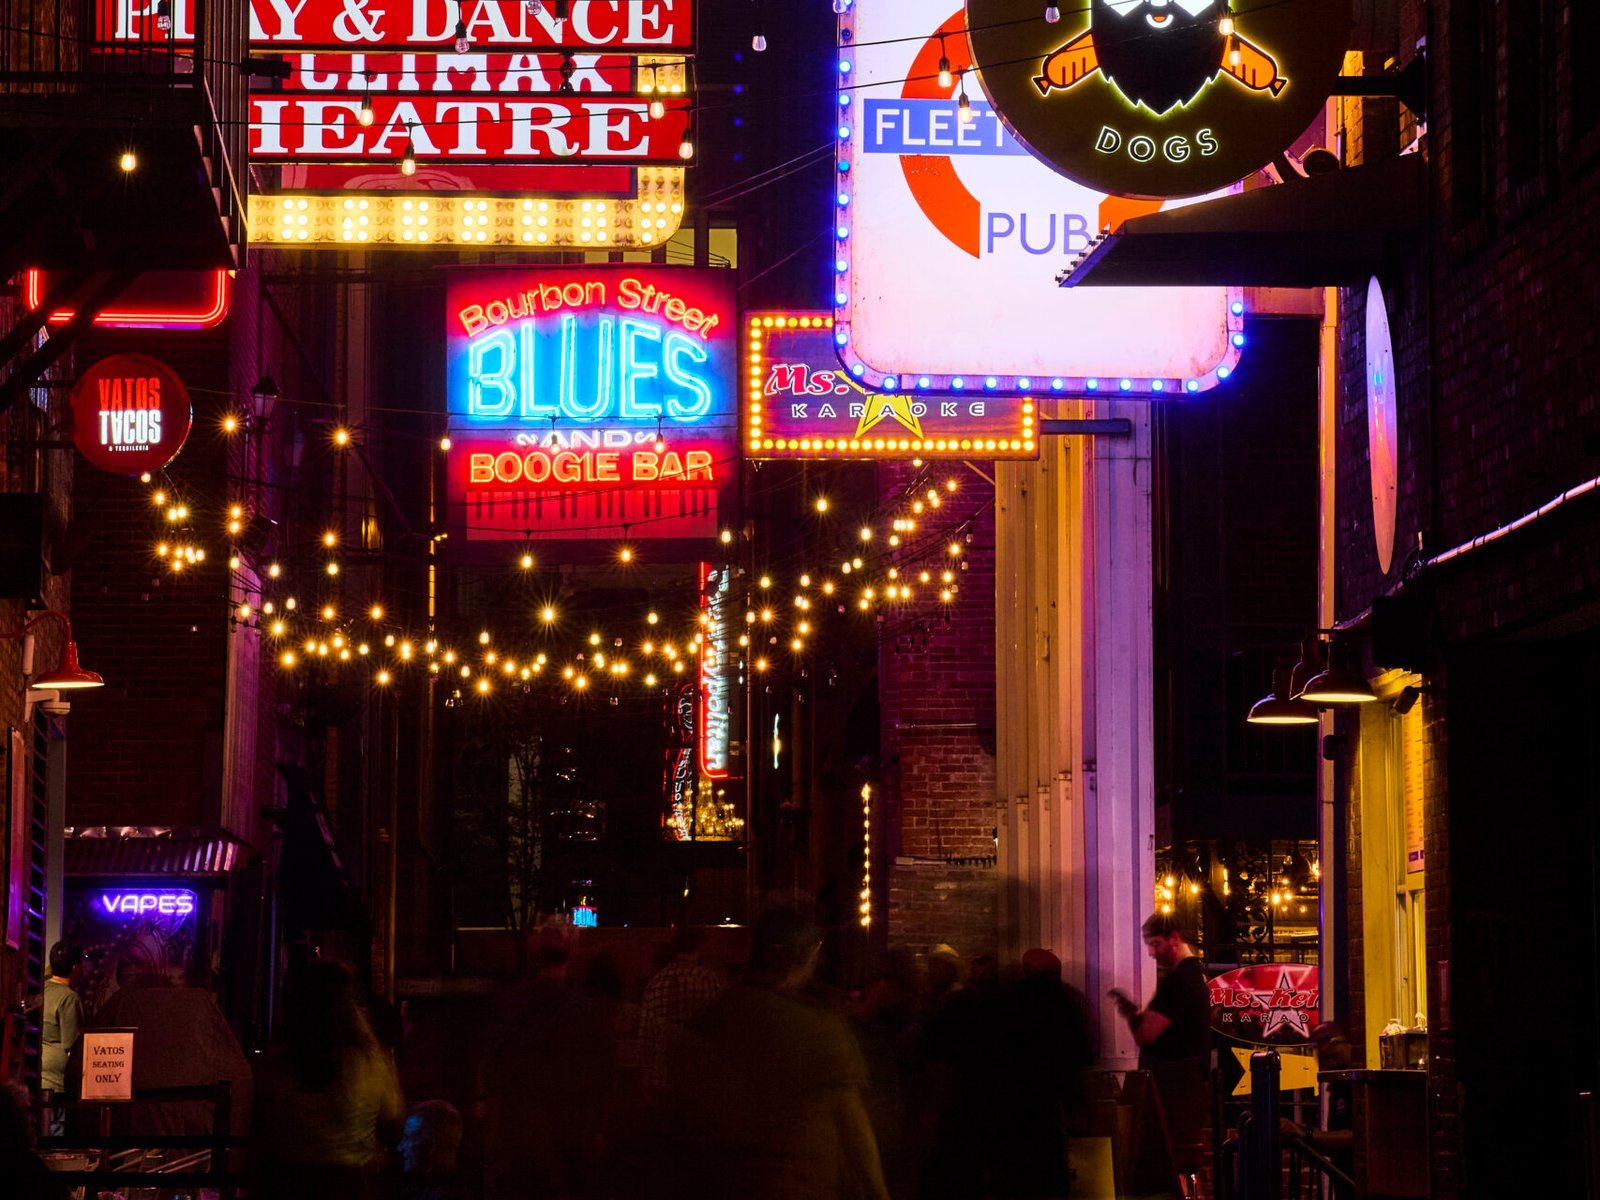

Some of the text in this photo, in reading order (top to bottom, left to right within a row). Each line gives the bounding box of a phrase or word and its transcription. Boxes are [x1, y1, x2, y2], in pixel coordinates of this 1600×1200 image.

[1095, 126, 1218, 162] DOGS
[987, 212, 1092, 255] PUB
[459, 278, 719, 339] Bourbon Street
[468, 314, 712, 422] BLUES
[764, 363, 849, 395] Ms.
[99, 377, 161, 410] VATOS
[792, 402, 985, 418] KARAOKE
[99, 409, 161, 444] TACOS
[540, 430, 633, 448] AND
[470, 450, 714, 483] BOOGIE BAR
[103, 894, 193, 915] VAPES
[1210, 988, 1260, 1008] Ms.
[1222, 1013, 1309, 1022] KARAO
[93, 1045, 125, 1056] VATOS
[92, 1060, 124, 1069] SEATING
[95, 1073, 122, 1084] ONLY
